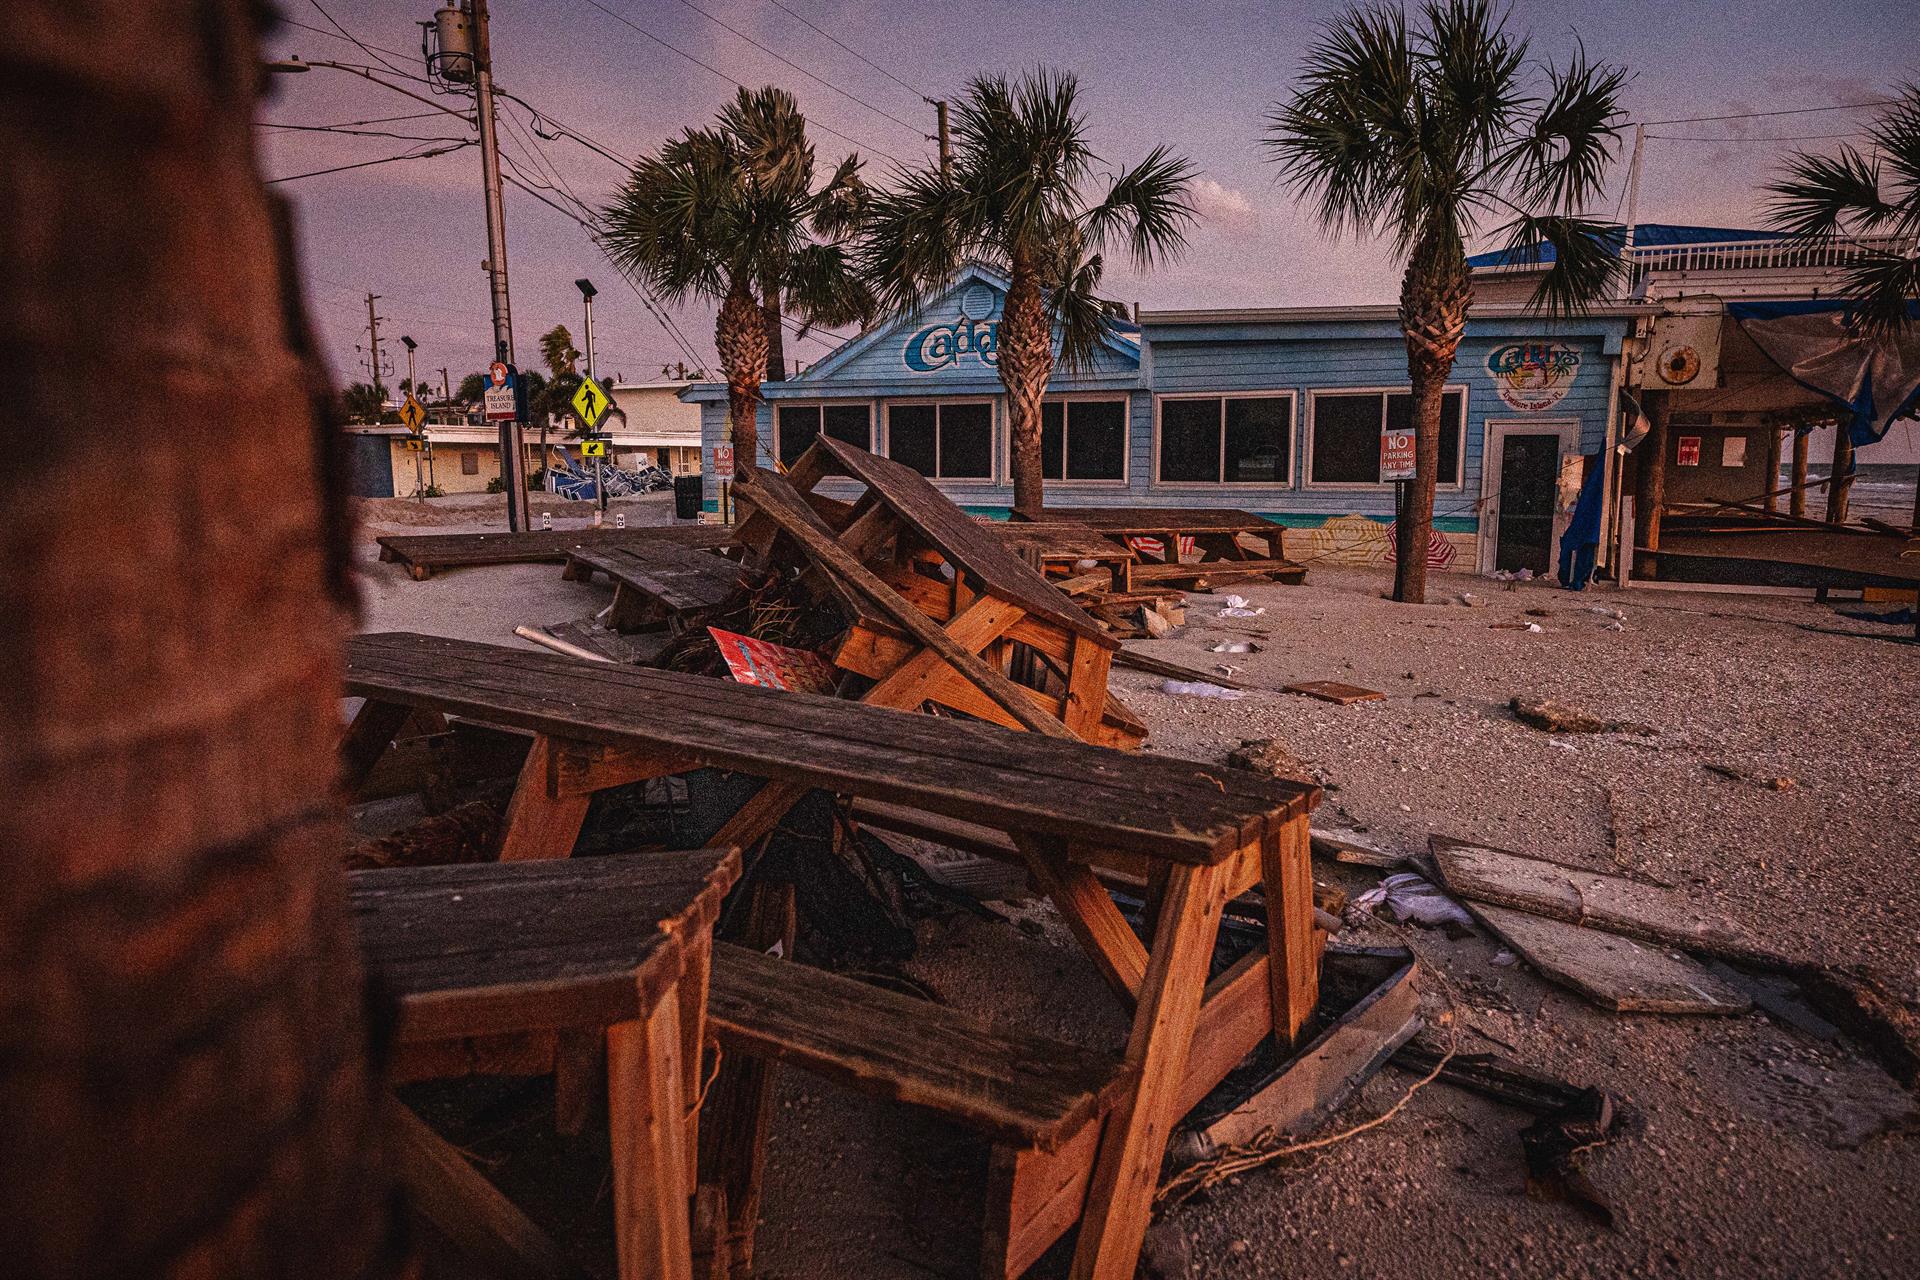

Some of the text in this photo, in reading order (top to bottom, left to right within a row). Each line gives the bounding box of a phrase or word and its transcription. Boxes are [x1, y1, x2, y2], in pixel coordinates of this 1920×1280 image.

[905, 317, 998, 372] Cadd
[486, 395, 515, 403] TREASURE
[1502, 389, 1529, 410] Treasure
[490, 402, 512, 410] ISLAND
[1388, 436, 1408, 450] NO
[717, 447, 730, 459] NO
[1383, 450, 1414, 460] PARKING
[1382, 460, 1415, 470] ANY TIME
